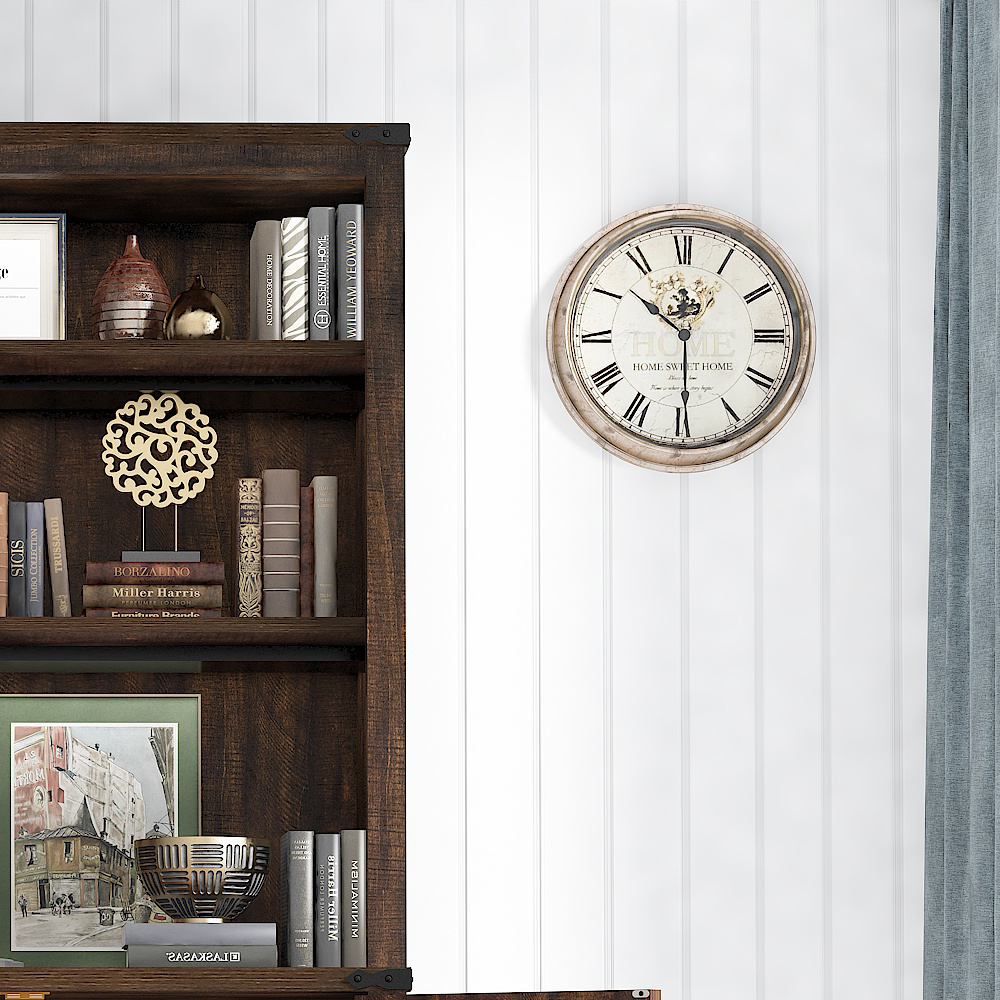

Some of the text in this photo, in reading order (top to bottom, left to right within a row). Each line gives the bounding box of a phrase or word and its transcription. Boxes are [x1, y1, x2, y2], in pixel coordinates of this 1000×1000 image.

[317, 235, 327, 263] HOME
[317, 264, 327, 306] ESSENTIAL
[346, 220, 357, 338] WILLIAM YEOWARD
[633, 363, 663, 371] HOME
[702, 363, 733, 371] HOME
[10, 540, 25, 577] SICIS
[50, 516, 64, 573] TRUSSARDI
[114, 567, 191, 577] BORZALINO
[112, 588, 201, 598] Miller Harris
